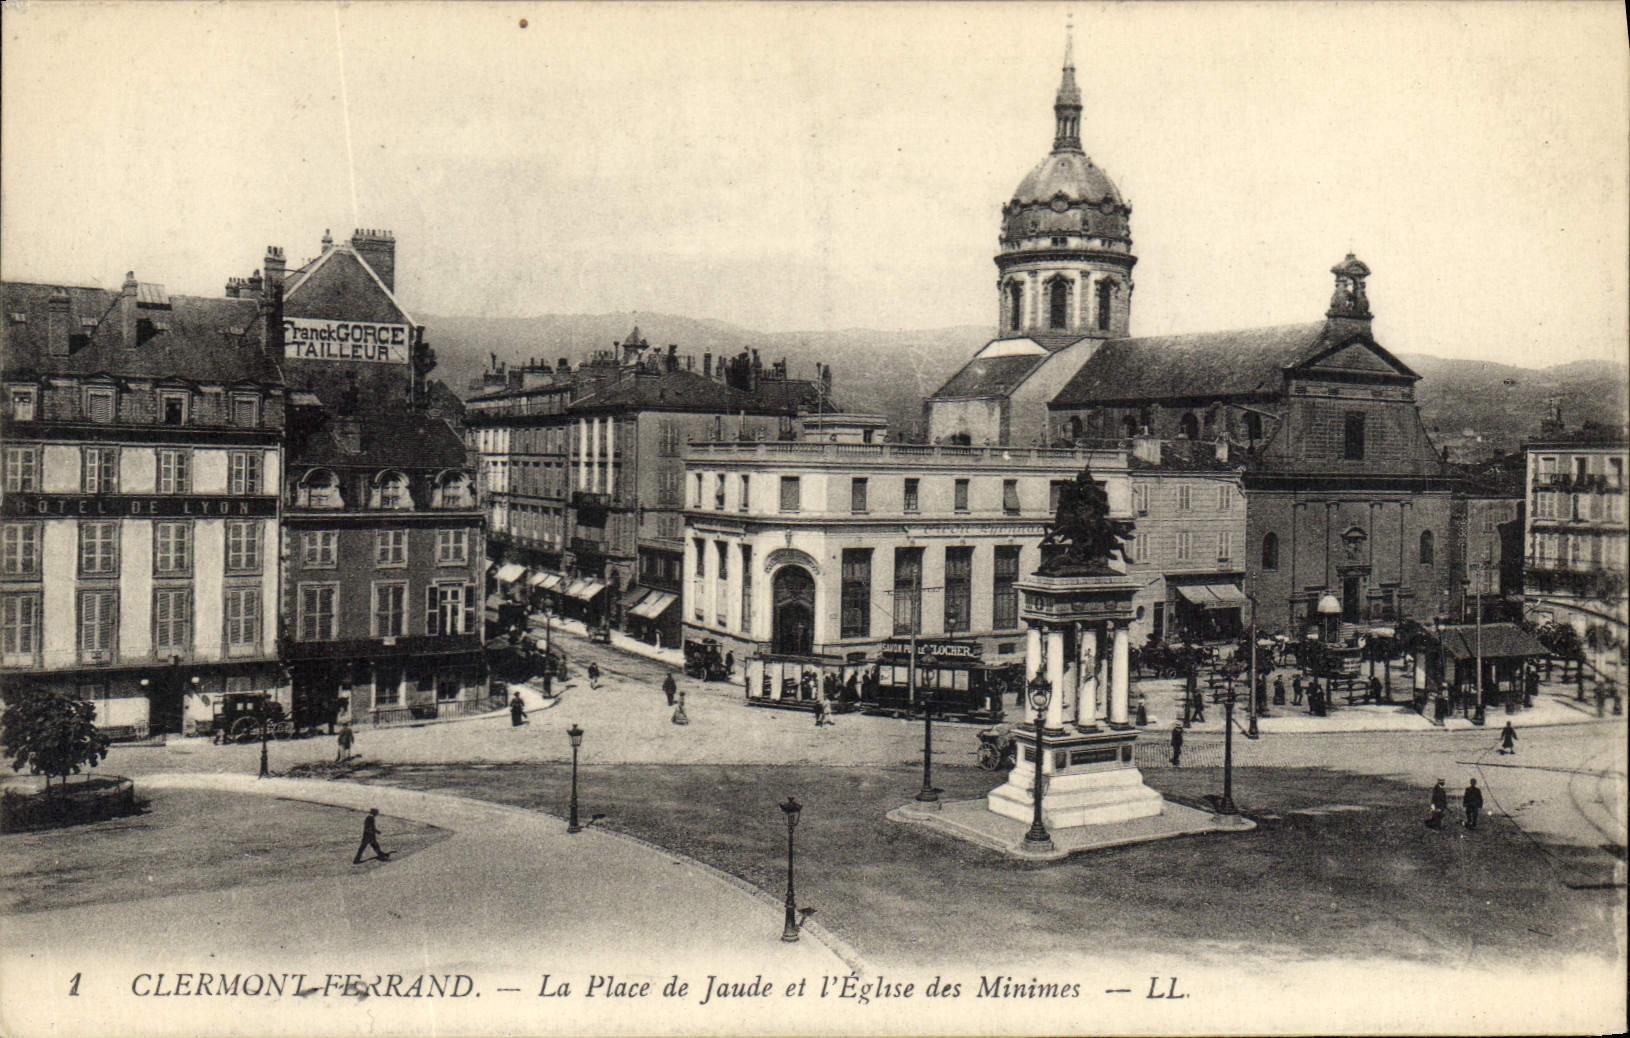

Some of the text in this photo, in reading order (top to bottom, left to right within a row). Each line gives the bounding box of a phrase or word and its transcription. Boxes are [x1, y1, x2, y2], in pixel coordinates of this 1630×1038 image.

[337, 323, 405, 346] GORCE
[284, 341, 389, 361] TAILLEUR
[131, 500, 159, 514] DE
[183, 500, 250, 514] LYON
